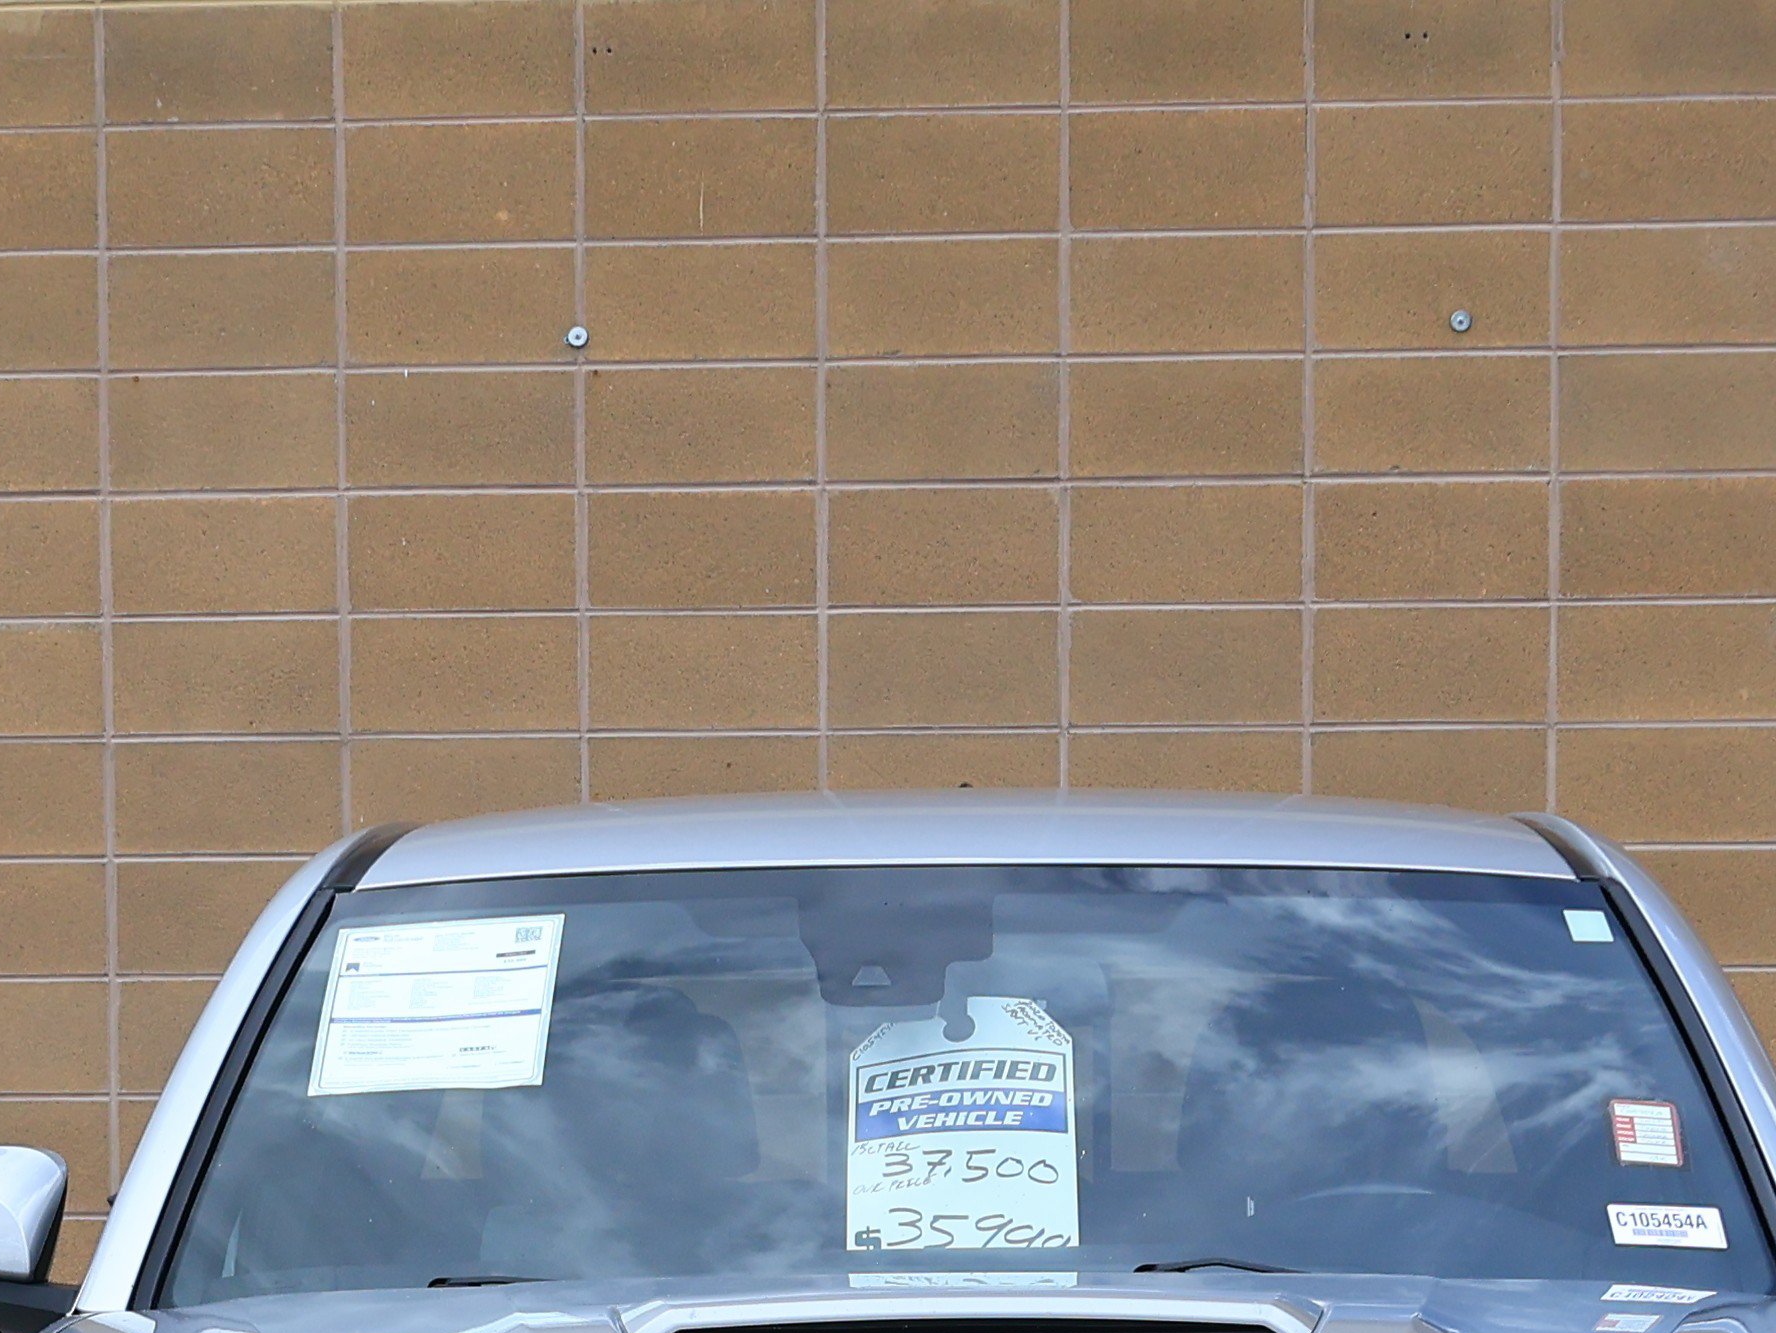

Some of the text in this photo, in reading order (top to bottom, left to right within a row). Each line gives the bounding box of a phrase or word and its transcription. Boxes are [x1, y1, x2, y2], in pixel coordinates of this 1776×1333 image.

[864, 1059, 1058, 1094] CERTIFIED
[869, 1090, 1054, 1117] PRE-OWNED
[897, 1110, 1023, 1132] VEHICLE
[882, 1148, 1059, 1184] 37,500
[1615, 1211, 1708, 1229] C105454A
